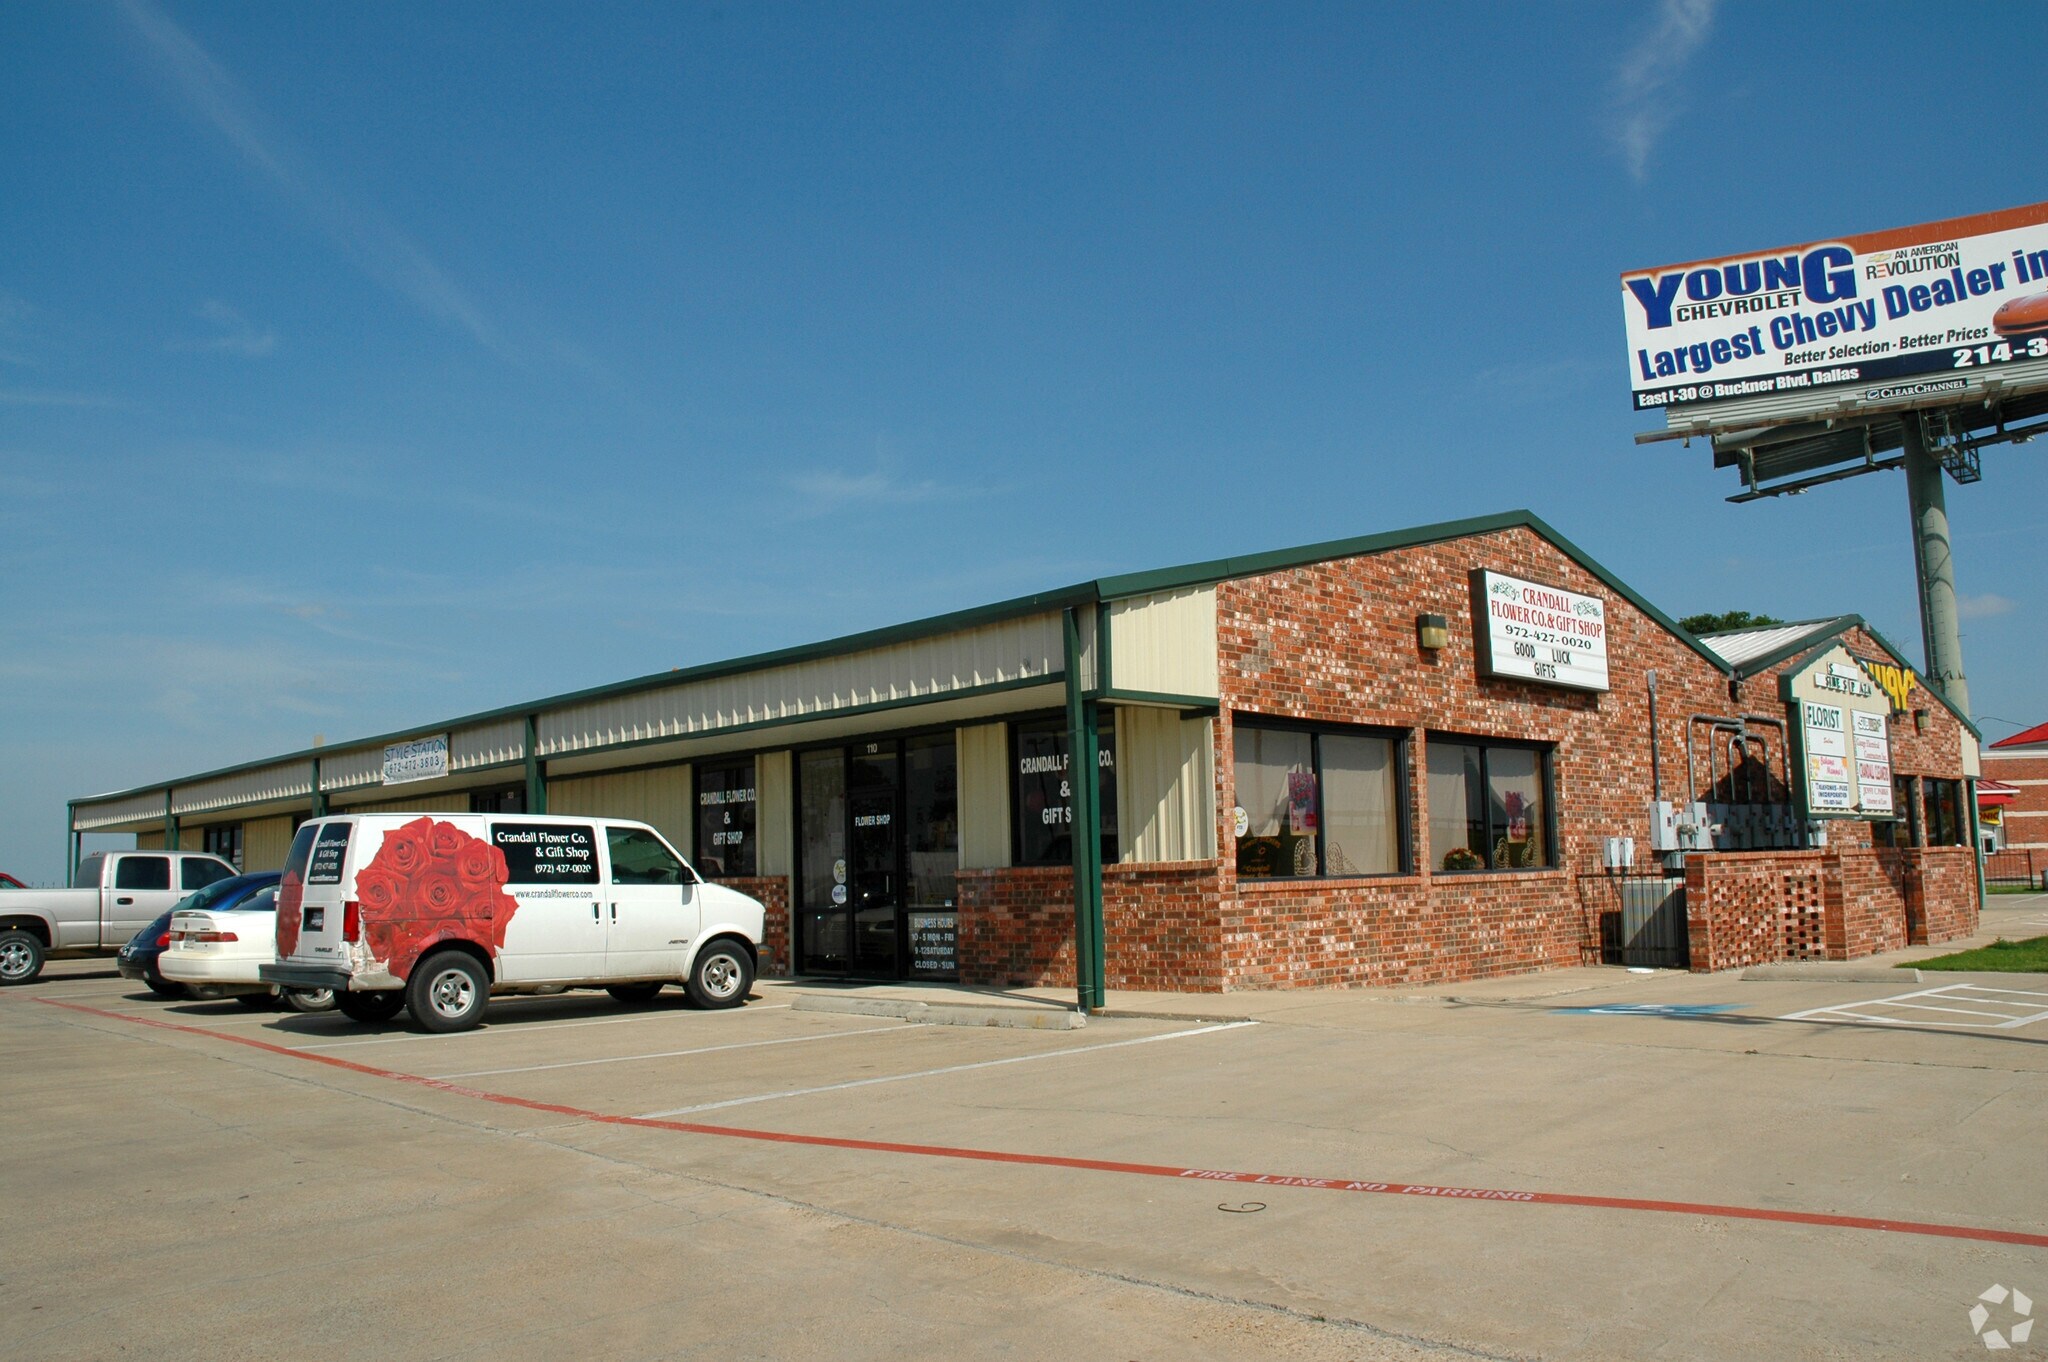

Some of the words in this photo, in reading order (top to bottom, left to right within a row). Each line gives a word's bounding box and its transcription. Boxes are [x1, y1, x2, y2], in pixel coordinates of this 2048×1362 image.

[1894, 250, 1908, 260] AN
[1910, 242, 1959, 257] AMERICAN
[1865, 252, 1961, 280] REVOLUTION
[1625, 246, 1858, 330] YOUNG
[1676, 291, 1802, 322] CHEVROLET
[1637, 325, 1766, 381] Largest
[1769, 298, 1877, 351] Chevy
[1881, 261, 2007, 321] Dealer
[1784, 349, 1826, 366] Better
[1828, 341, 1890, 360] Selection
[1899, 333, 1944, 350] Better
[1947, 327, 1989, 342] Prices
[1953, 337, 2048, 368] 214-3
[1638, 391, 1668, 407] East
[1669, 388, 1697, 403] I-30
[1699, 385, 1713, 398] @
[1715, 378, 1775, 397] Buckner
[1776, 371, 1812, 390] Blvd,
[1813, 367, 1860, 385] Dallas
[1522, 587, 1572, 614] CRANDALL
[1491, 600, 1531, 624] FLOWER
[1547, 613, 1555, 630] &
[1556, 615, 1577, 634] GIFT
[1578, 620, 1603, 639] SHOP
[1505, 624, 1592, 650] 972-427-0020
[1513, 641, 1536, 659] GOOD
[1551, 649, 1572, 666] LUCK
[1534, 662, 1557, 679] GIFTS
[1807, 705, 1840, 729] FLORIST
[385, 746, 410, 763] STYLE
[411, 738, 448, 758] STATION
[866, 743, 878, 754] 110
[1021, 755, 1062, 774] CRANDALL
[1098, 750, 1113, 767] CO.
[700, 791, 726, 806] CRANDALL
[726, 789, 747, 803] FLOWER
[1060, 780, 1071, 797] &
[723, 811, 731, 825] &
[855, 815, 876, 827] FLOWER
[876, 814, 891, 826] SHOP
[1042, 807, 1064, 825] GIFT
[496, 831, 537, 843] Crandall
[538, 832, 569, 843] Flower
[571, 833, 588, 843] Co.
[713, 832, 727, 846] GIFT
[727, 831, 743, 845] SHOP
[535, 846, 544, 858] &
[545, 846, 564, 858] Gift
[565, 846, 590, 861] Shop
[534, 864, 555, 874] (972)
[515, 889, 593, 899] www.crandallflowerco.com
[914, 961, 938, 969] CLOSED
[1180, 1168, 1248, 1181] FIRE
[1255, 1175, 1335, 1188] LANE
[1346, 1181, 1388, 1192] NO
[1402, 1185, 1535, 1201] PARKING
